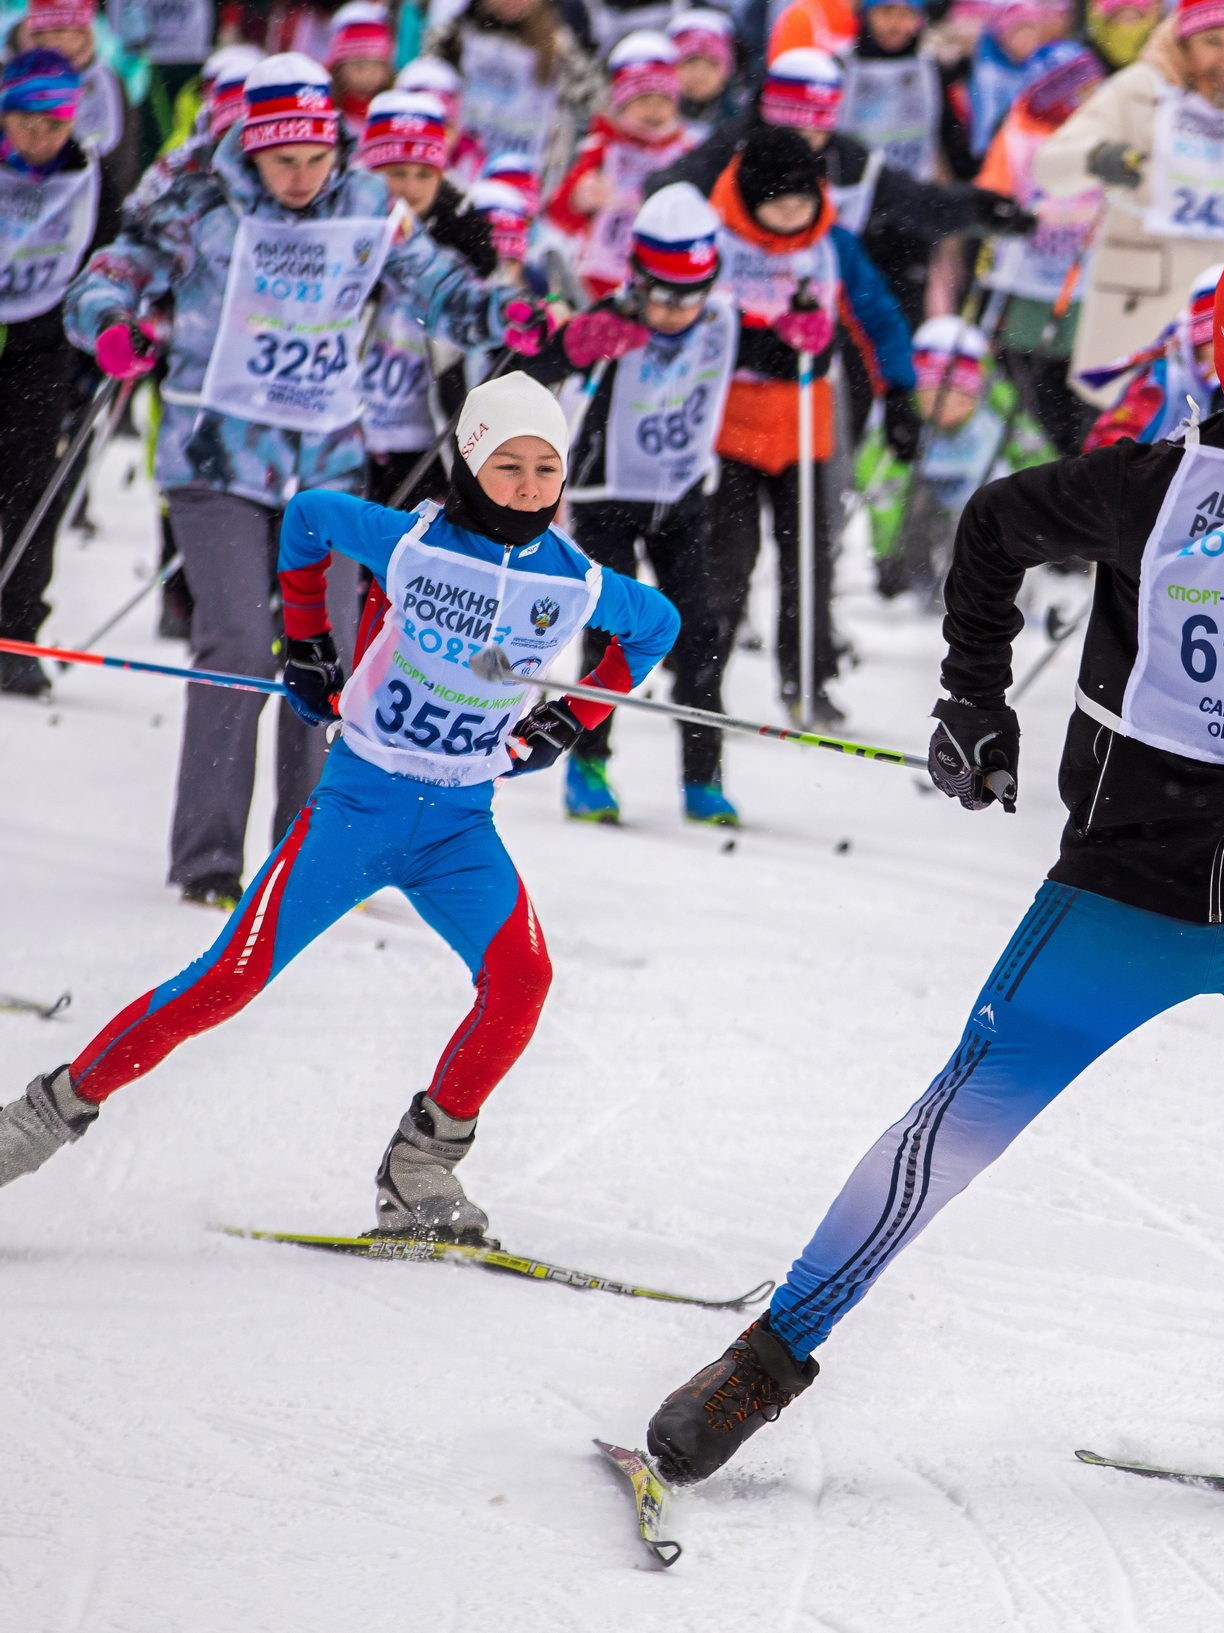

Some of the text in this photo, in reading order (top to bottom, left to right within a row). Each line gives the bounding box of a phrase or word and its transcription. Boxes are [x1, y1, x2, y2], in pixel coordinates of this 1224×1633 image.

[247, 331, 348, 383] 3254
[402, 592, 494, 643] РОССИИ
[405, 575, 500, 620] ЛЫЖНЯ
[1167, 583, 1221, 606] СПОРТ
[375, 679, 511, 757] 3554
[432, 684, 489, 710] НОРМА
